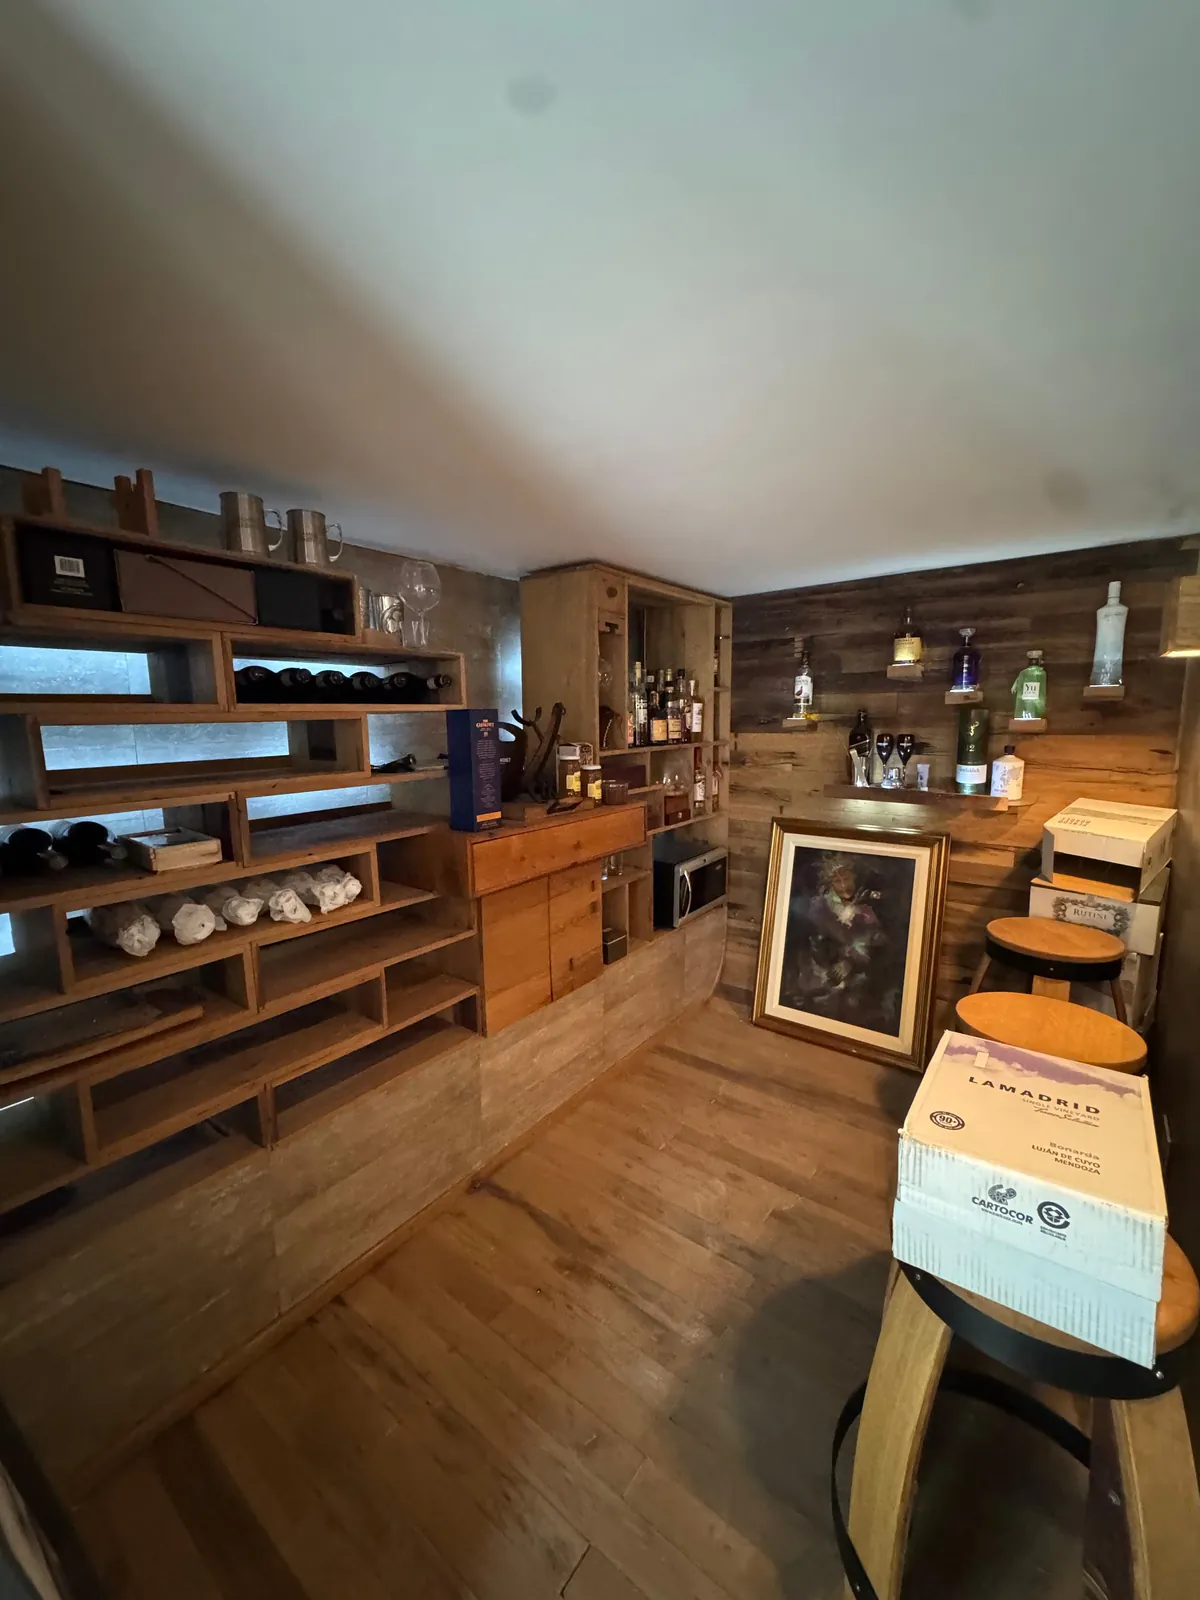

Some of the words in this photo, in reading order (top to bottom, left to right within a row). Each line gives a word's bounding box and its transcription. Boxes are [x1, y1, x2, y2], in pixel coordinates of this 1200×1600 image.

[1073, 908, 1107, 920] RUTINI
[968, 1076, 1100, 1114] LAMADRID
[1053, 1106, 1100, 1121] VINEYARD
[1031, 1144, 1059, 1157] LUJÁN
[1074, 1157, 1101, 1169] CUYO
[1049, 1141, 1100, 1161] Bonarda
[1054, 1157, 1101, 1175] MENDOZA
[971, 1196, 1034, 1225] CARTOCOR
